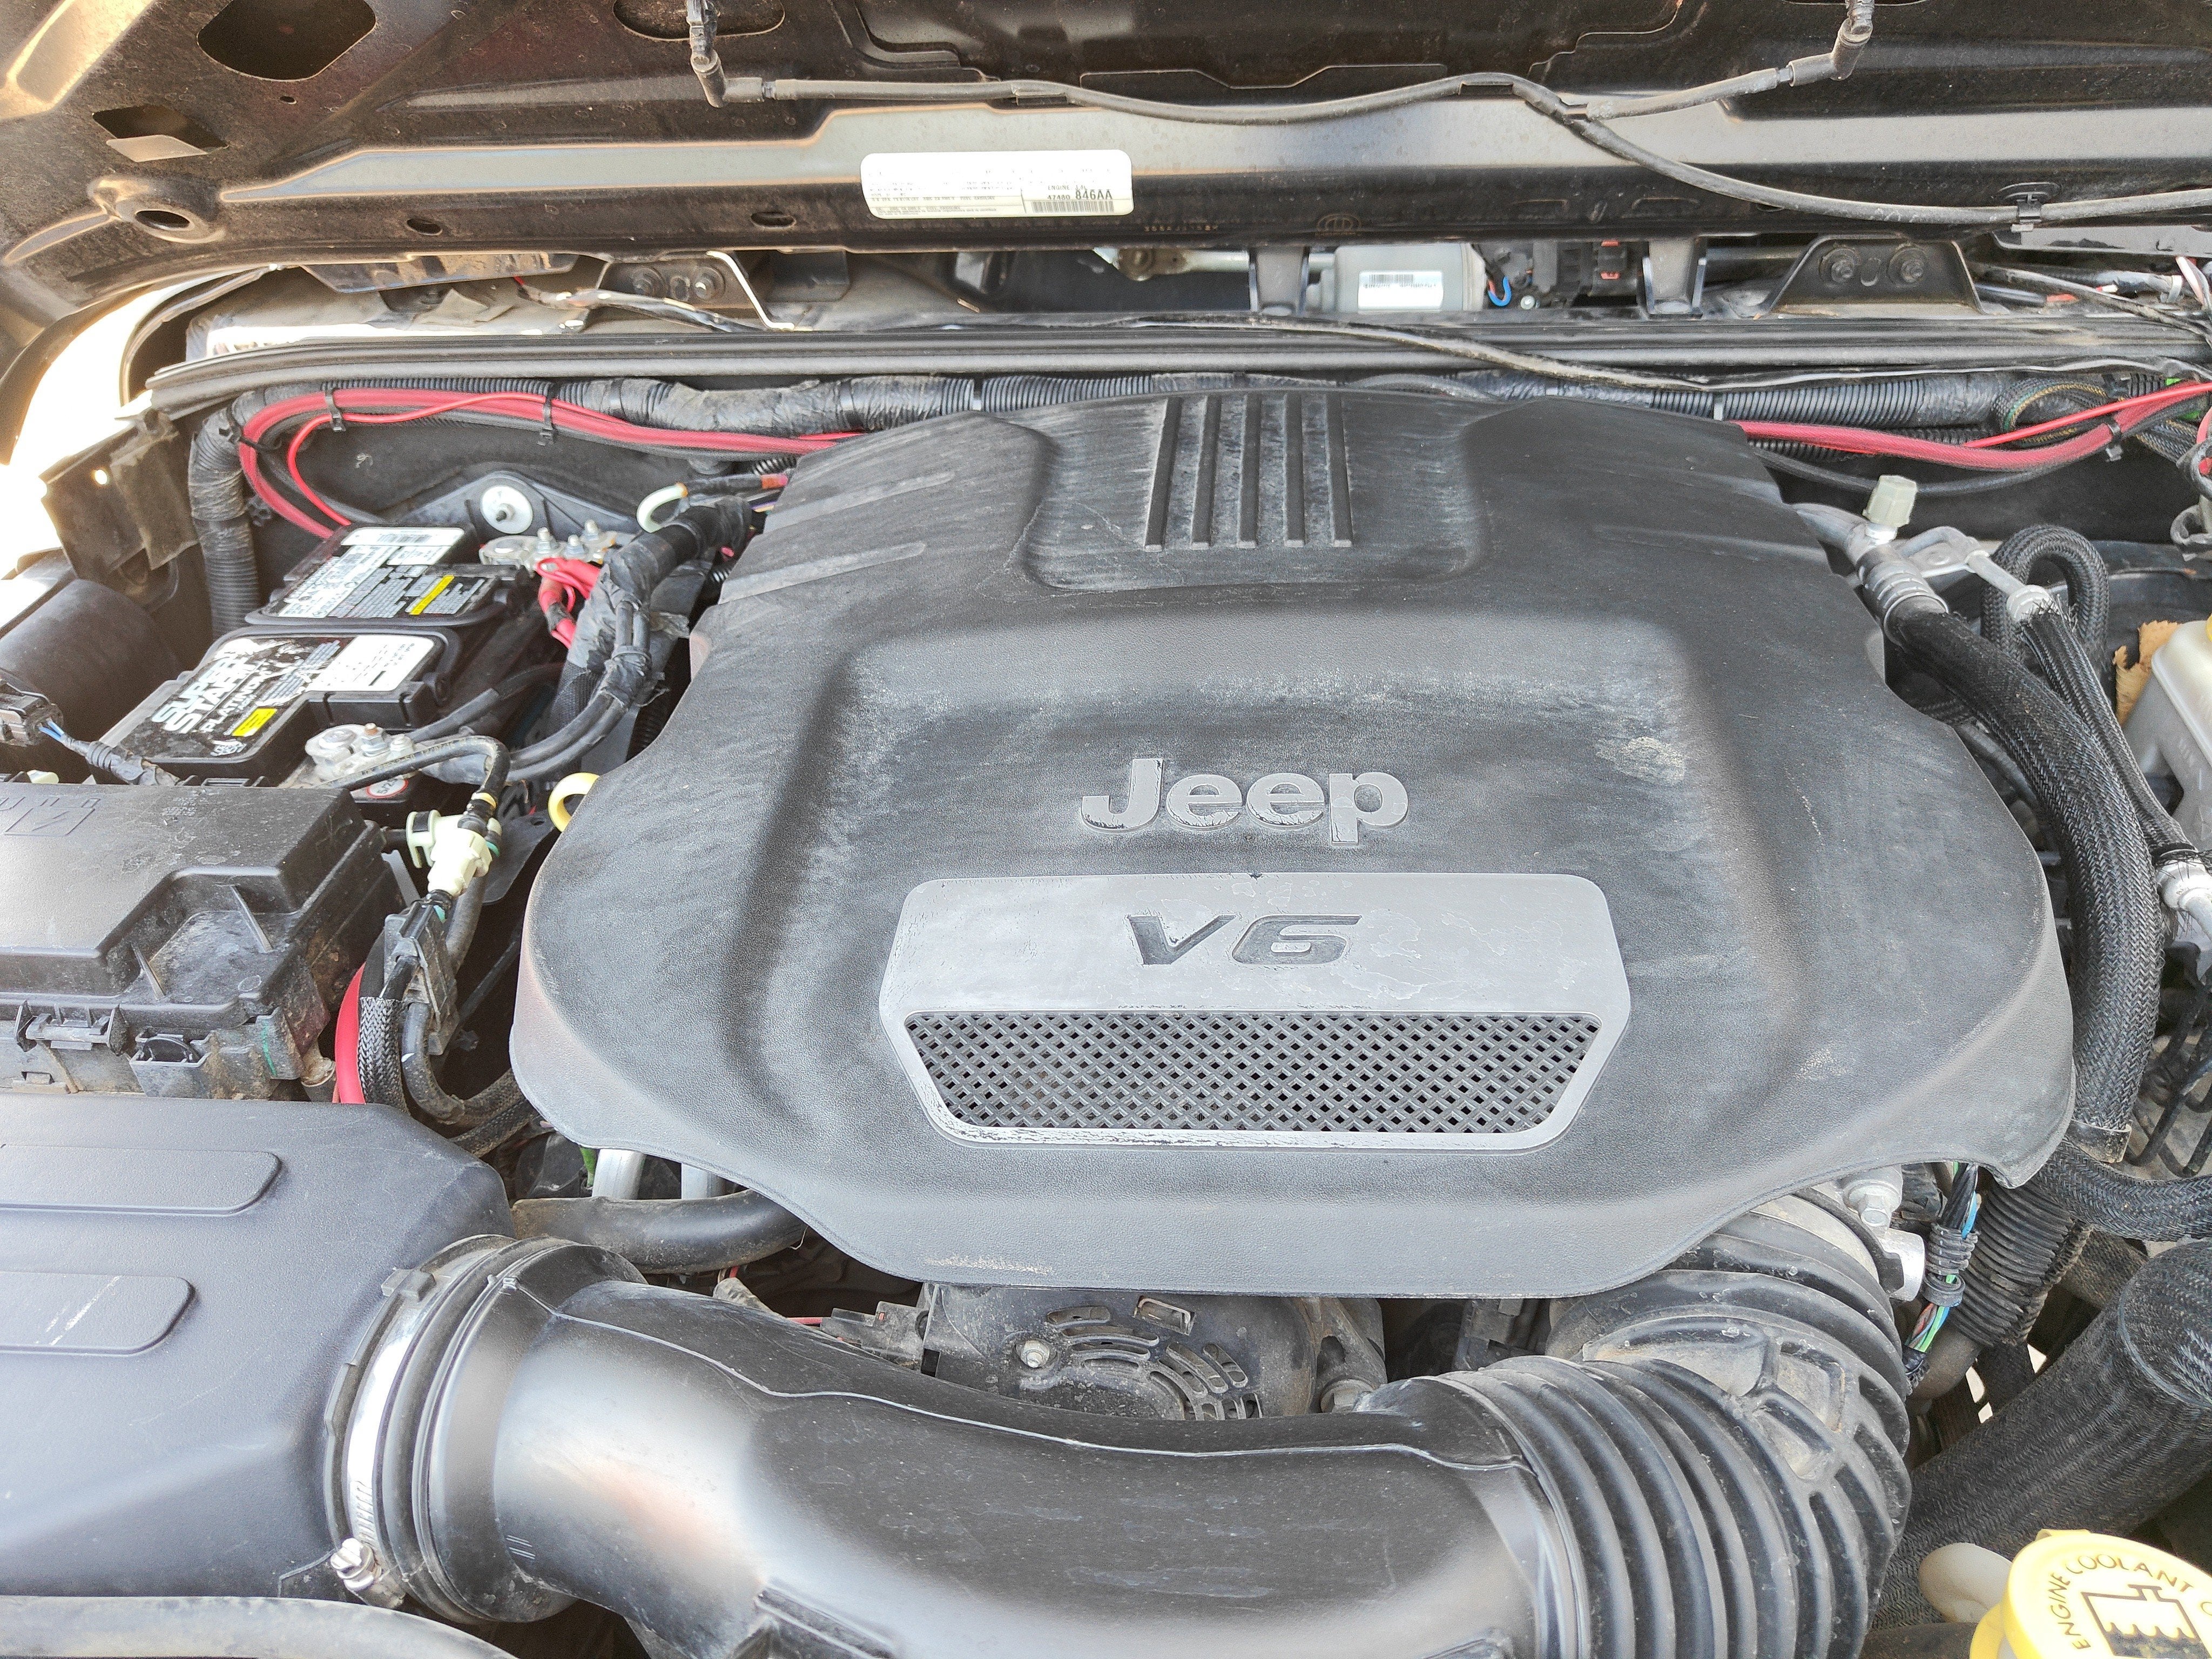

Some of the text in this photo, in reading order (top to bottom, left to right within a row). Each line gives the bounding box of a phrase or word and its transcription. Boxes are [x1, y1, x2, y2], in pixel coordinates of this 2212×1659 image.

[1075, 189, 1112, 200] 846AA
[151, 656, 241, 723] SUPER
[164, 657, 259, 734] START
[1081, 758, 1409, 846] Jeep
[1127, 914, 1363, 965] V6
[2048, 1554, 2194, 1650] ENGINE COOLANT
